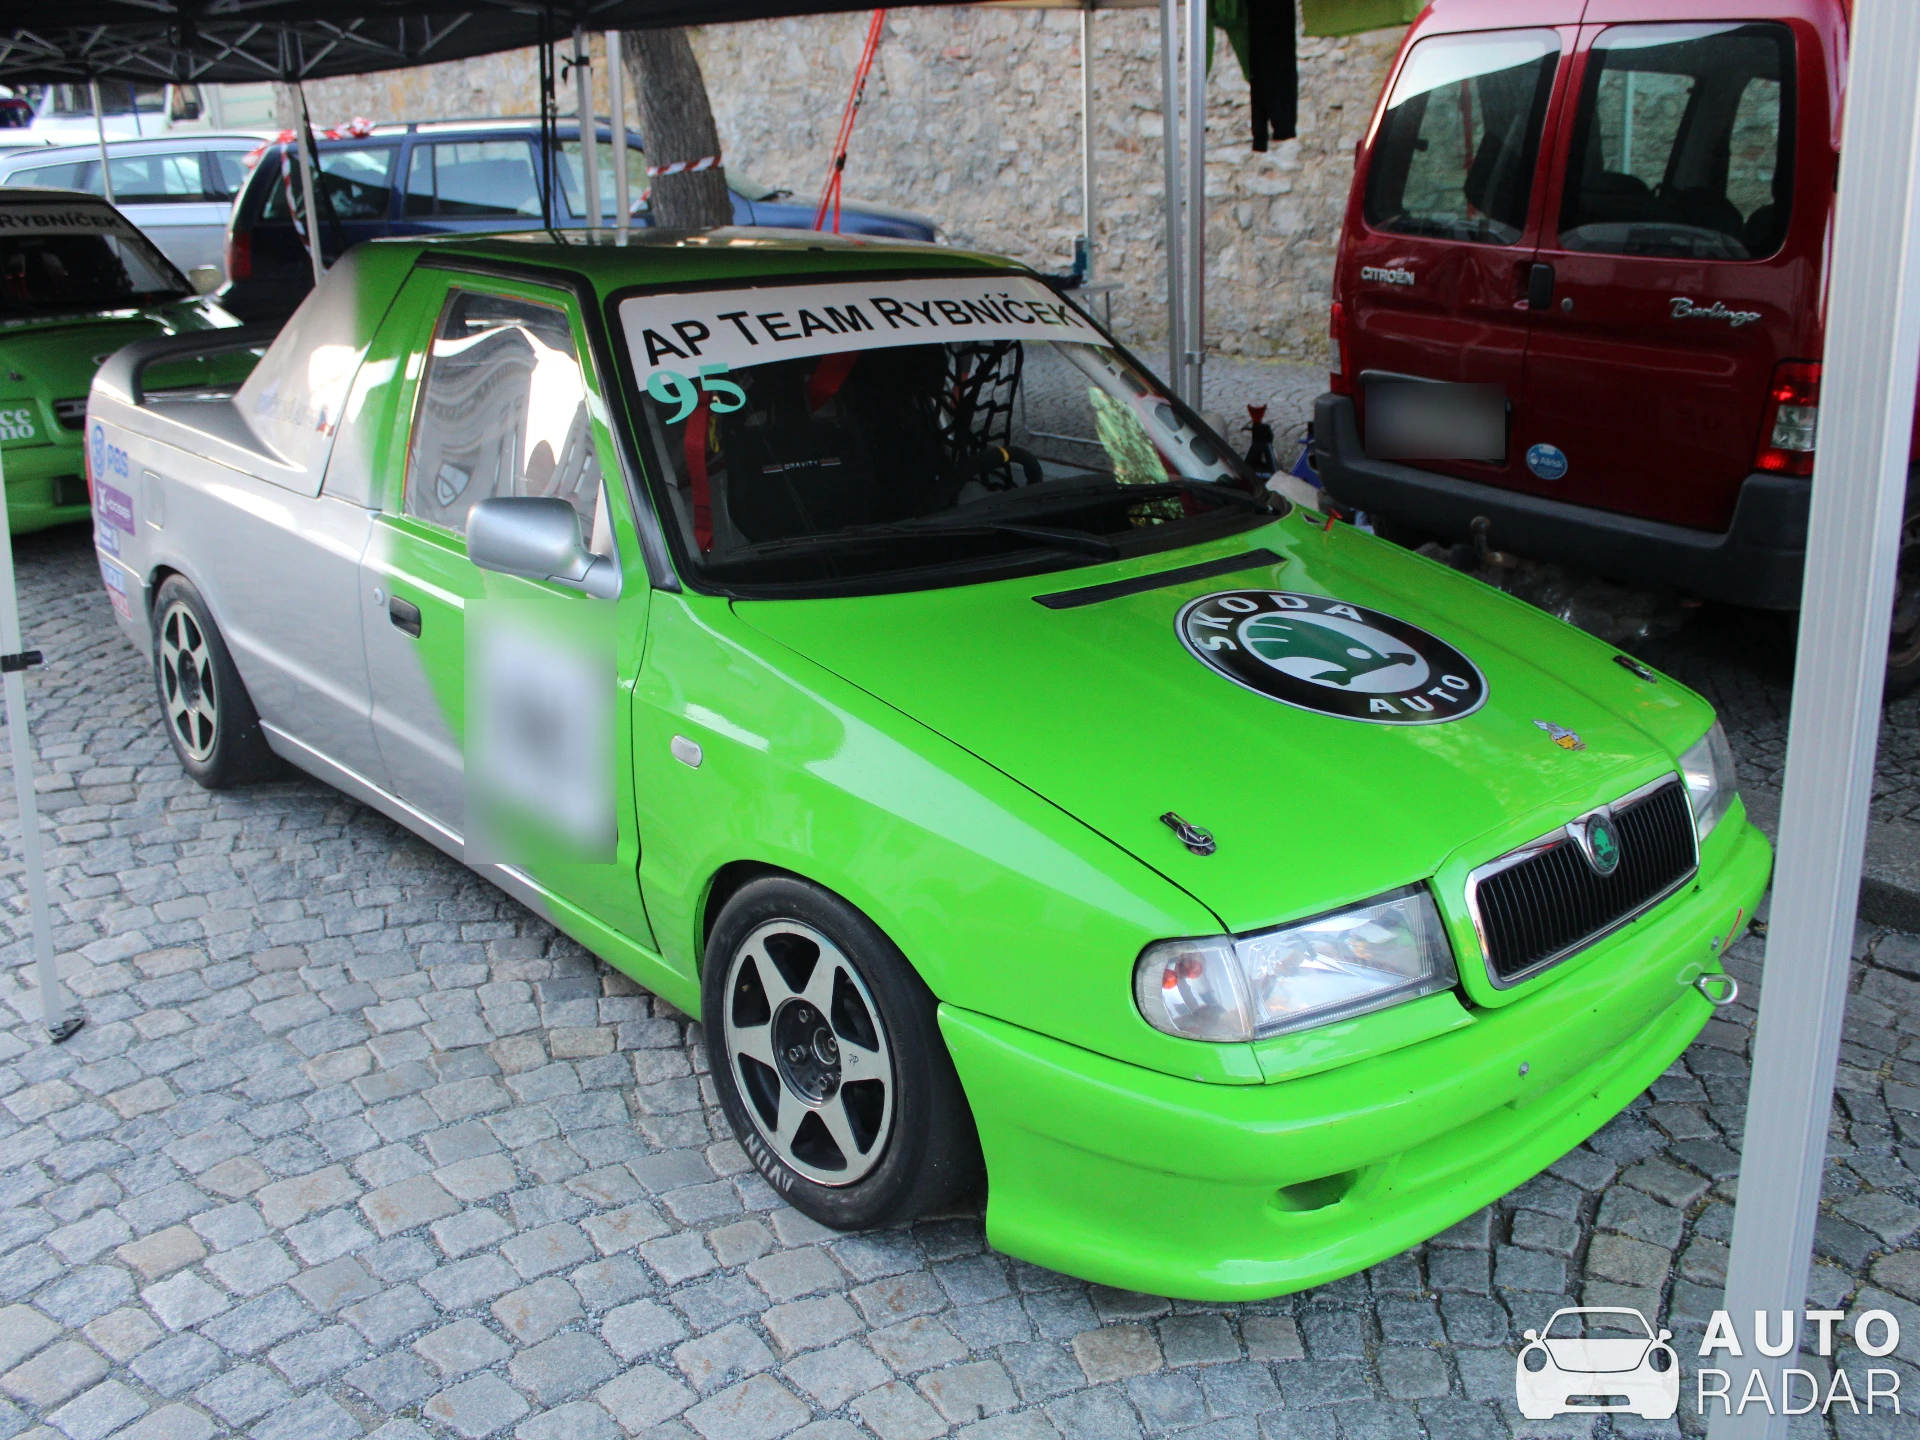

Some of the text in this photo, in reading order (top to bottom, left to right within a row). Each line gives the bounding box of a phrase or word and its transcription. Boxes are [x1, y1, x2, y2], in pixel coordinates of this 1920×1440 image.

[1360, 266, 1415, 285] CITROËN
[1669, 297, 1762, 327] Berlingo
[641, 319, 711, 366] AP
[717, 303, 873, 346] TEAM
[646, 363, 746, 425] 95
[783, 459, 819, 470] GRAVITY
[1369, 673, 1471, 714] AUTO
[743, 1132, 795, 1192] AVON
